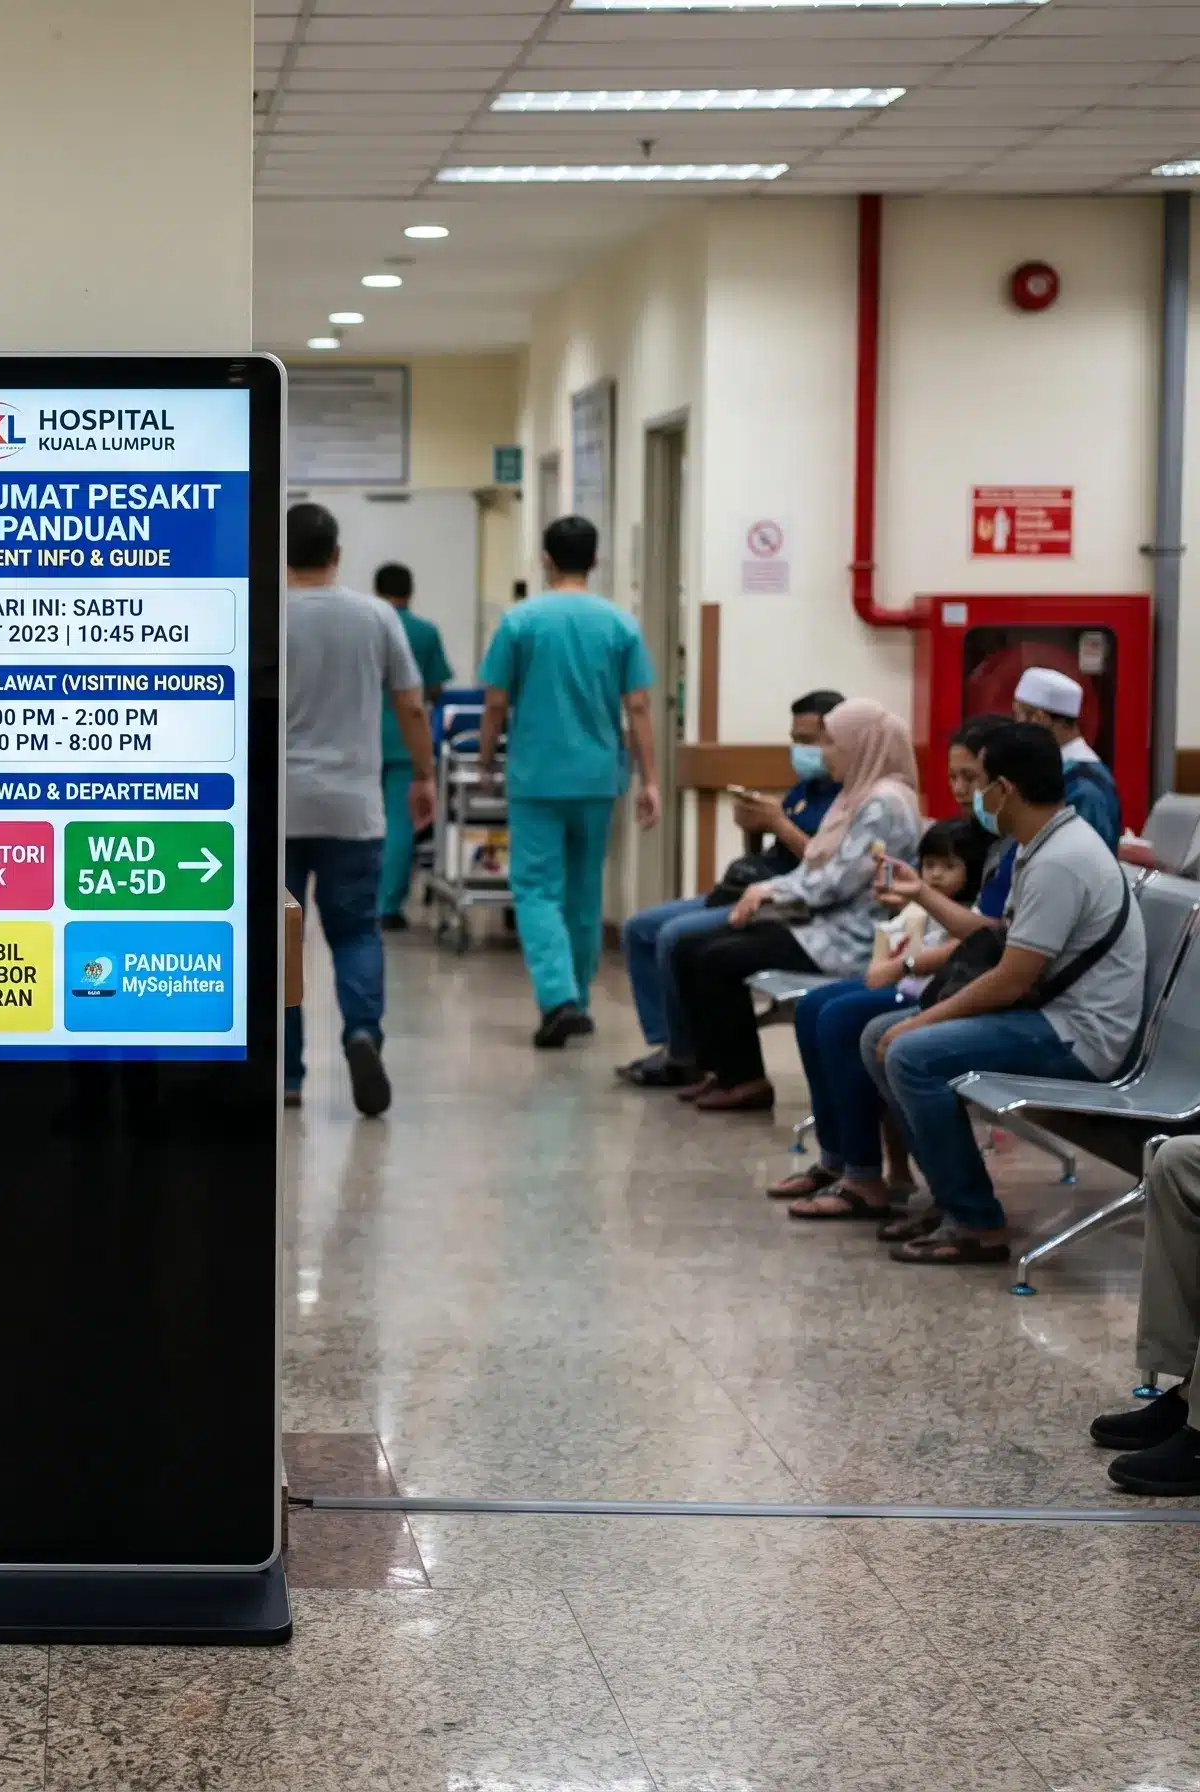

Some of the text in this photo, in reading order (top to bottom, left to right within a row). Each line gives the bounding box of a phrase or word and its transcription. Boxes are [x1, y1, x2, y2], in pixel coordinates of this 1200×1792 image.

[39, 409, 175, 431] HOSPITAL
[38, 437, 176, 451] KUALA LUMPUR
[88, 483, 222, 510] PESAKIT
[37, 548, 85, 567] INFO
[89, 548, 104, 567] &
[109, 548, 171, 567] GUIDE
[32, 598, 67, 617] INI:
[72, 598, 143, 617] SABTU
[8, 624, 59, 643] 2023
[78, 624, 135, 643] 10:45
[141, 624, 189, 643] PAGI
[61, 673, 149, 695] (VISITING
[154, 673, 225, 695] HOURS)
[22, 708, 55, 726] PM
[75, 708, 119, 726] 2:00
[125, 708, 158, 726] PM
[16, 733, 49, 751] PM
[69, 733, 113, 751] 8:00
[119, 733, 152, 751] PM
[46, 782, 61, 801] &
[65, 782, 199, 801] DEPARTEMEN
[87, 836, 155, 862] WAD
[78, 869, 166, 895] 5A-5D
[124, 953, 223, 972] PANDUAN
